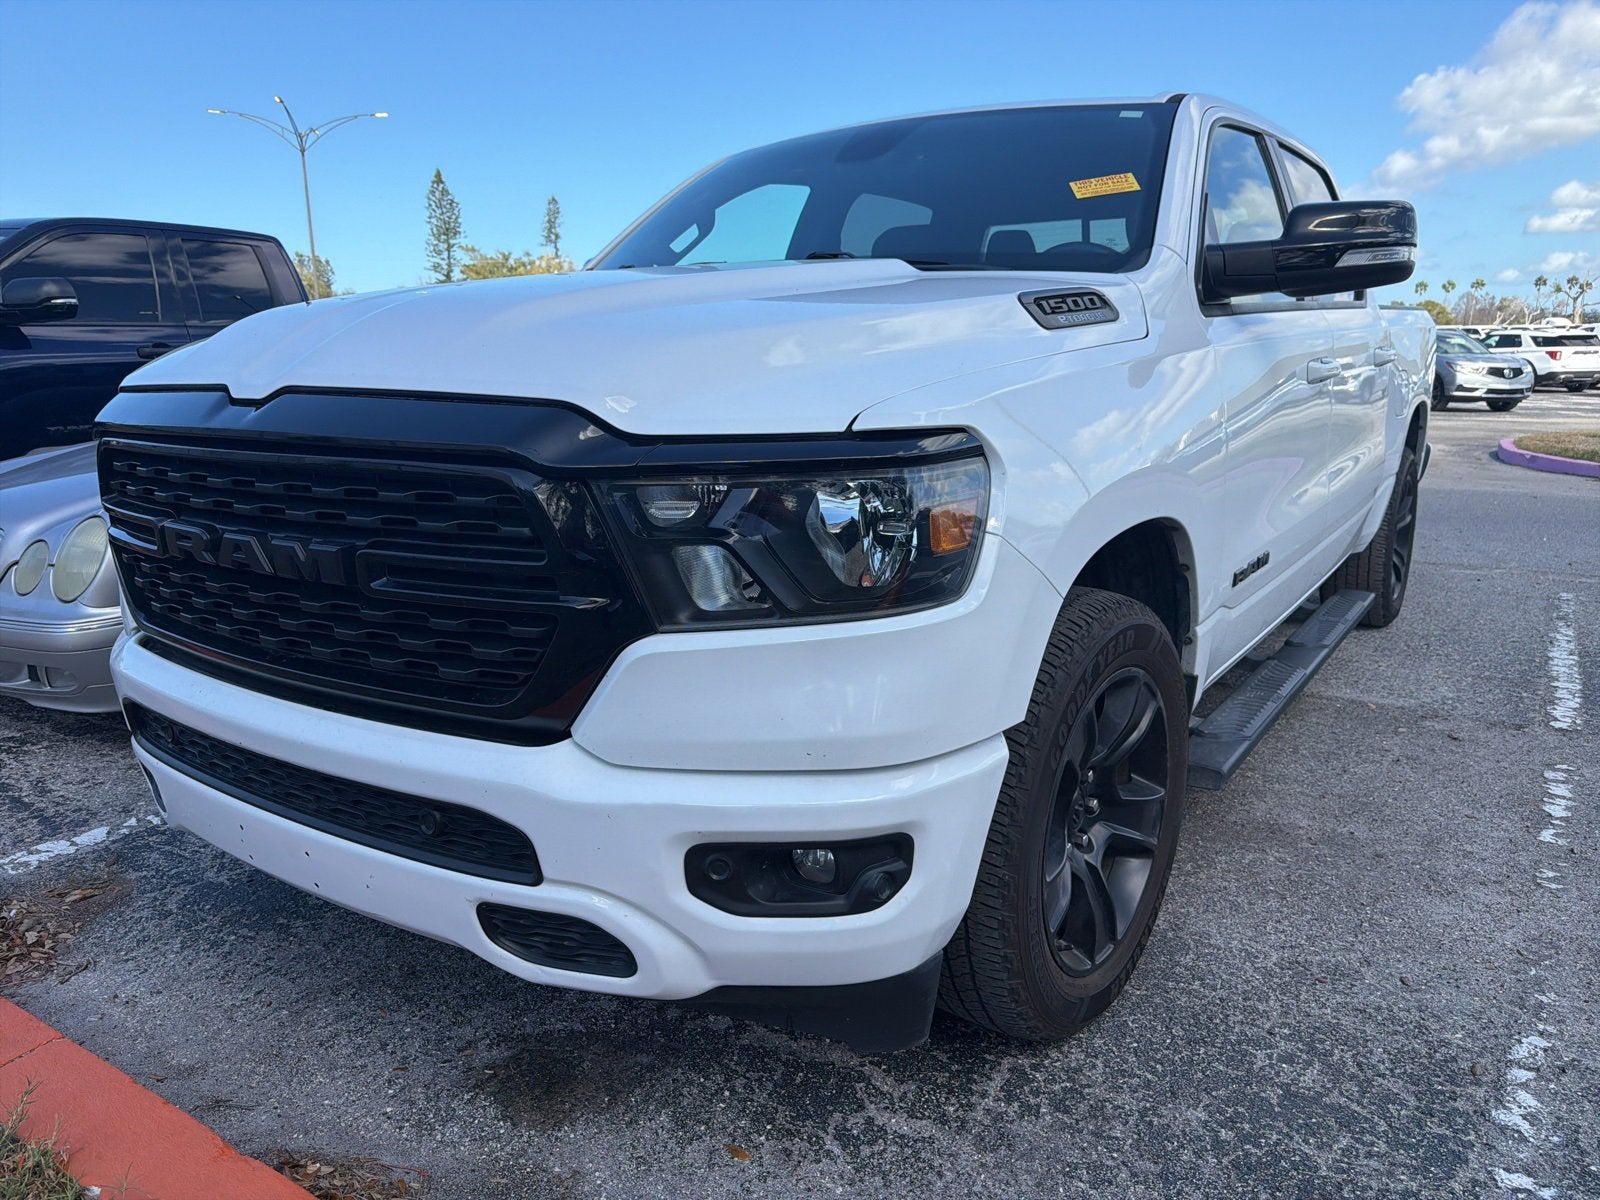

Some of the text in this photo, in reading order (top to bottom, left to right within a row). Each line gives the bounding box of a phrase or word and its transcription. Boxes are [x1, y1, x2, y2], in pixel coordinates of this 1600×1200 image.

[1094, 175, 1130, 183] VEHICLE
[1110, 178, 1130, 186] SALE
[1039, 295, 1101, 312] 1500
[163, 520, 349, 586] RAM
